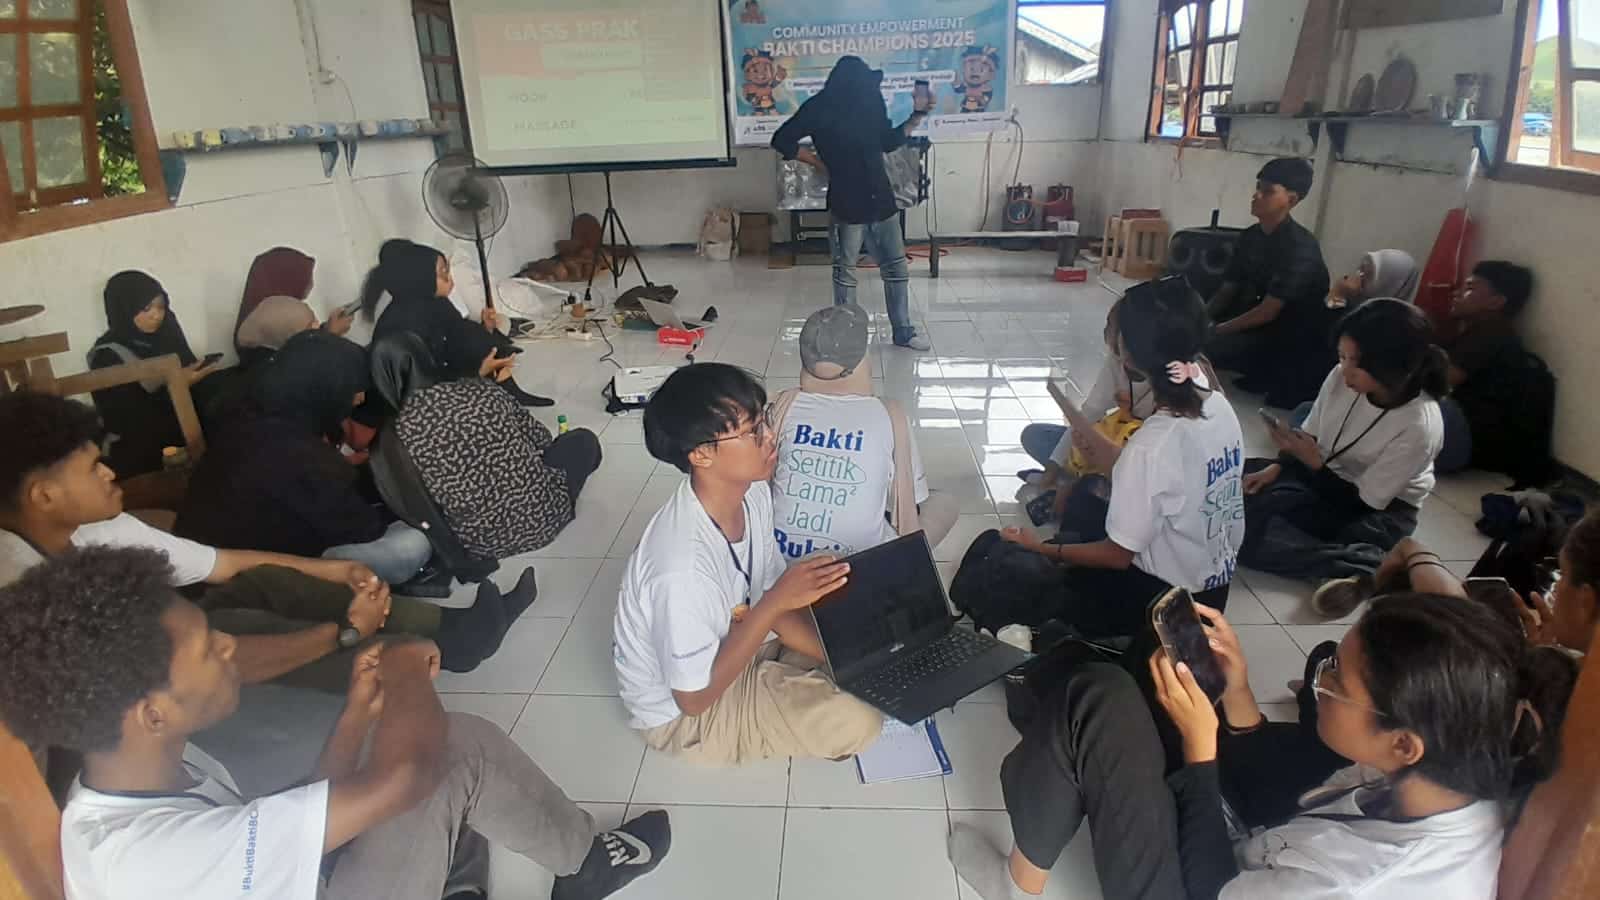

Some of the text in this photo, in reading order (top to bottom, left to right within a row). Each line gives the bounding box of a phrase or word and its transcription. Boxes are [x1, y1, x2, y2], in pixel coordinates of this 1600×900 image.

[772, 17, 964, 39] COMMUNITY EMPOWERMENT
[818, 33, 929, 55] CHAMPIONS
[933, 29, 975, 48] 2025
[793, 424, 864, 451] Bakti
[788, 449, 857, 481] Setitik
[786, 502, 833, 534] Jadi
